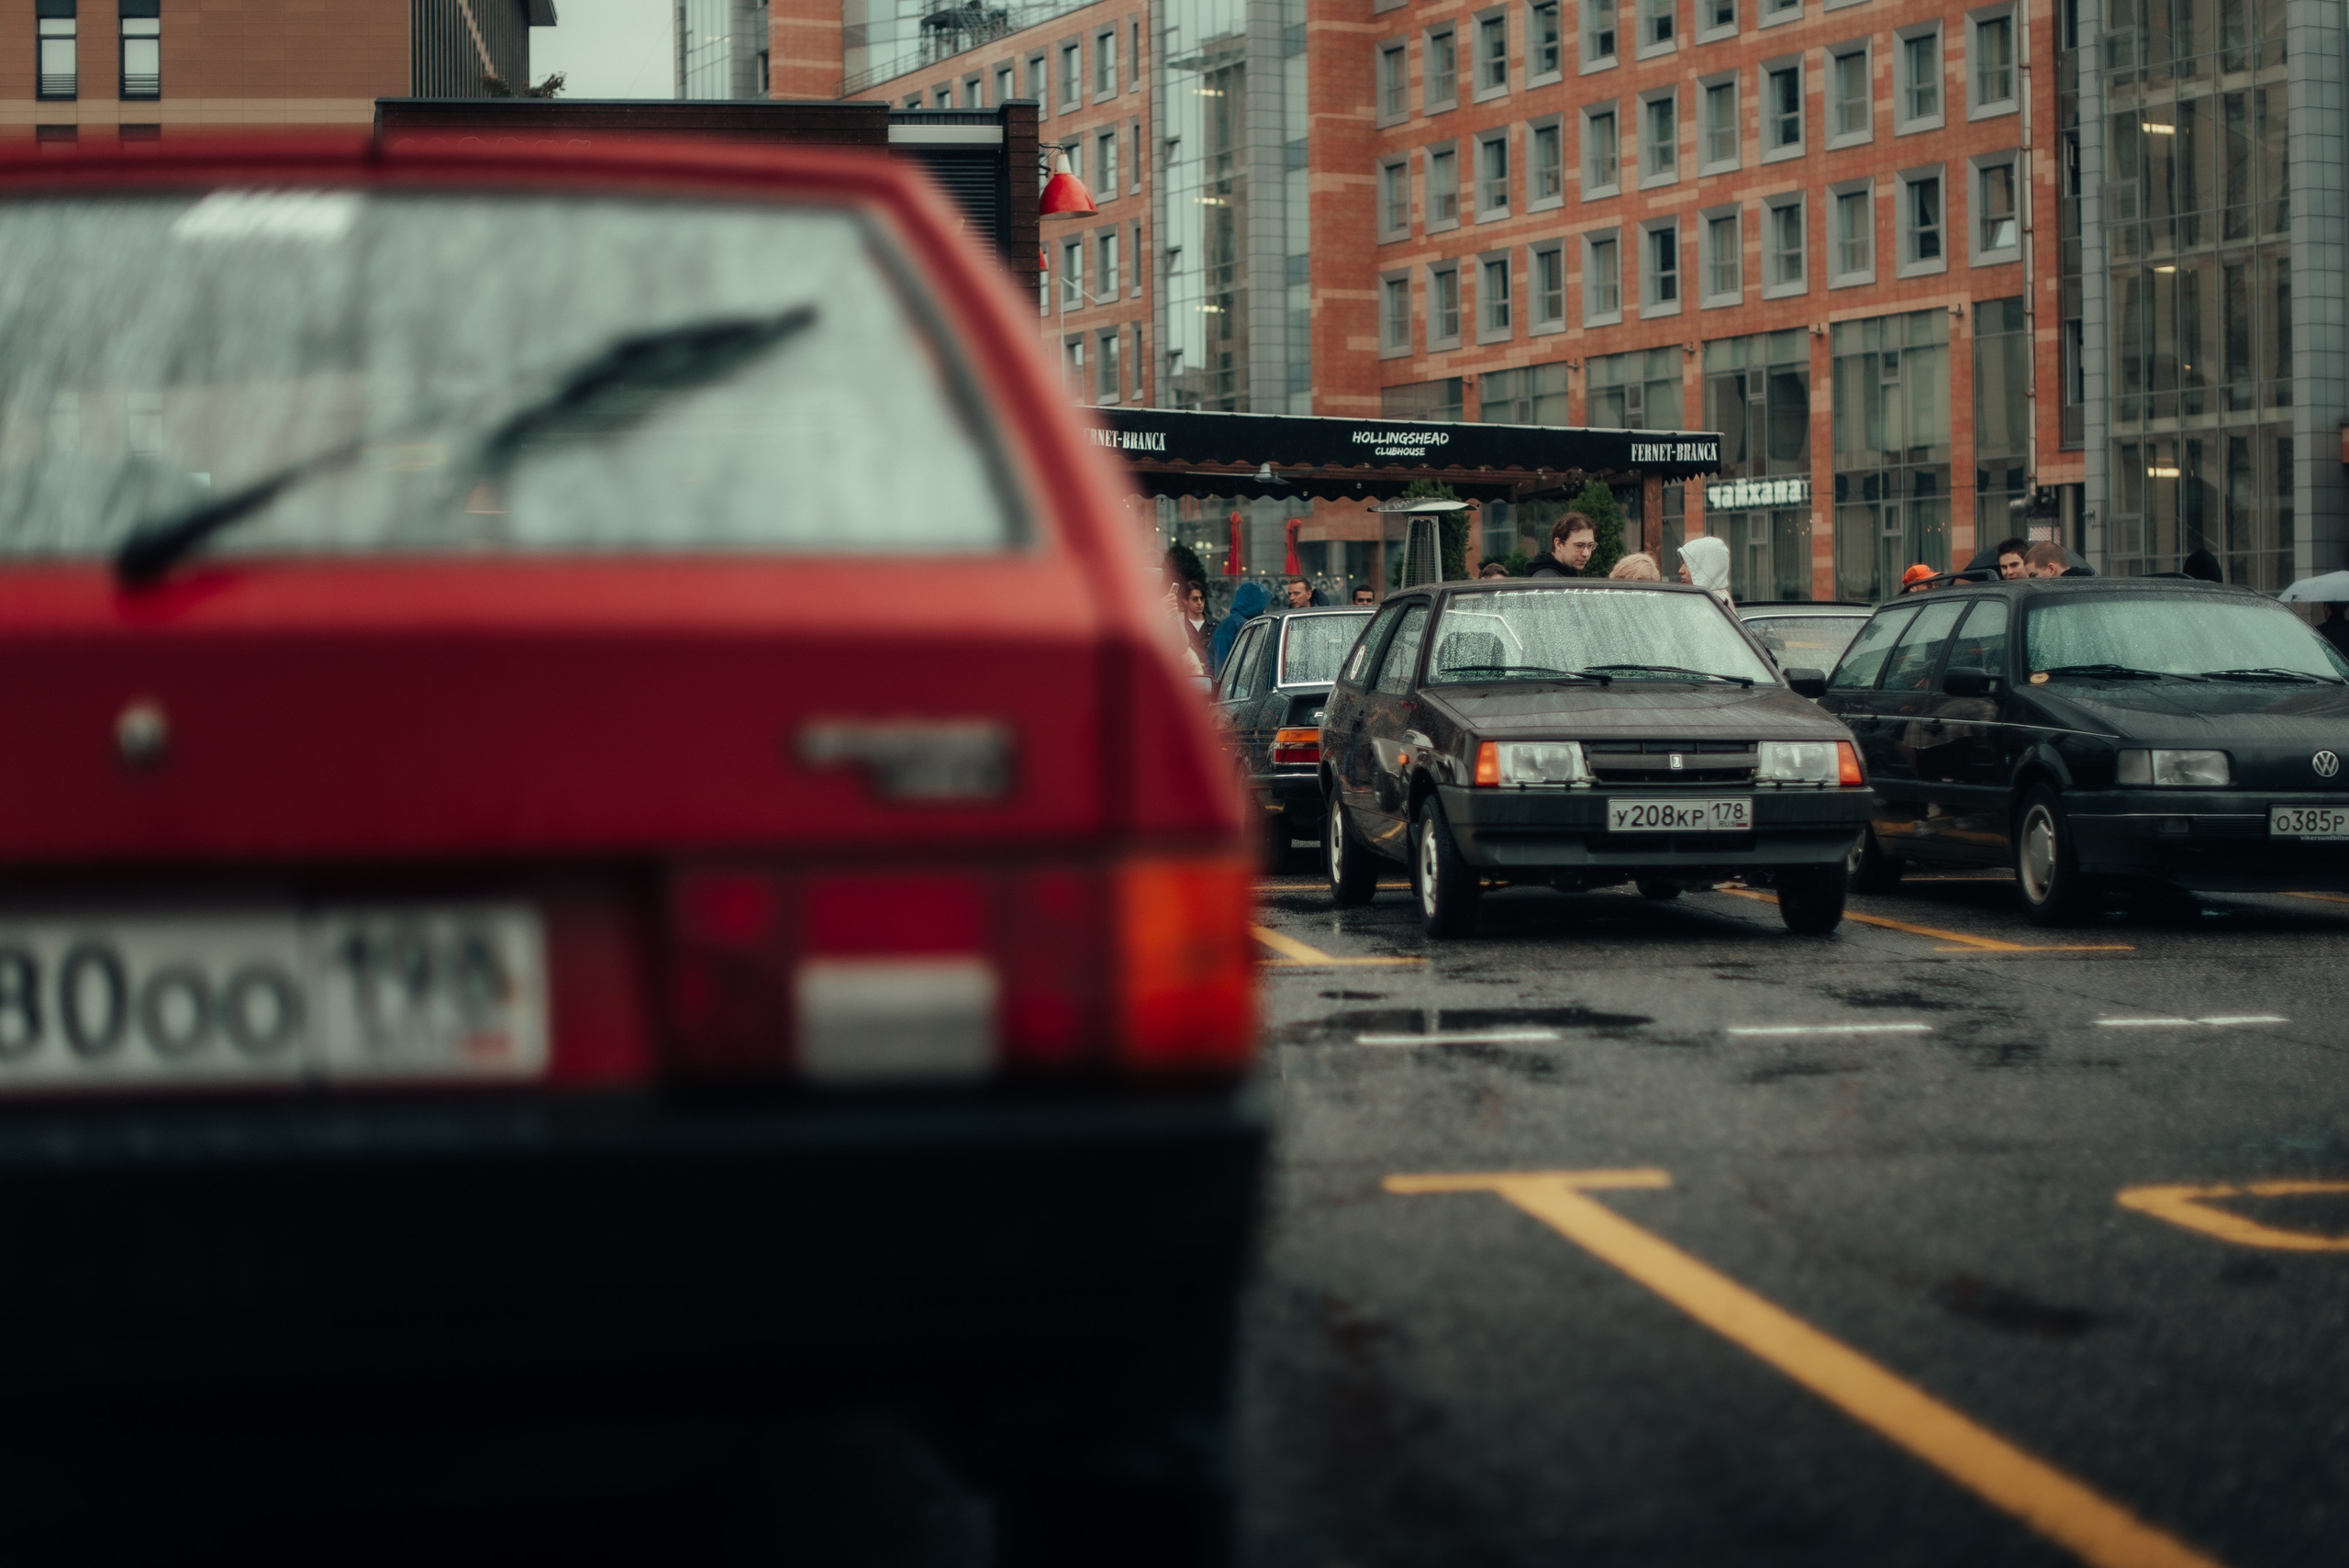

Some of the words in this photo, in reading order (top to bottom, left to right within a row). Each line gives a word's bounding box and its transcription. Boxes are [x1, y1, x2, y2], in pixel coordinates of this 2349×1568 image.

[1353, 431, 1450, 446] HOLLINGSHEAD
[1375, 447, 1426, 456] CLUBHOUSE
[1631, 443, 1718, 462] FERNET-BRANCA
[1708, 478, 1802, 509] чайхана
[1711, 803, 1743, 820] 178
